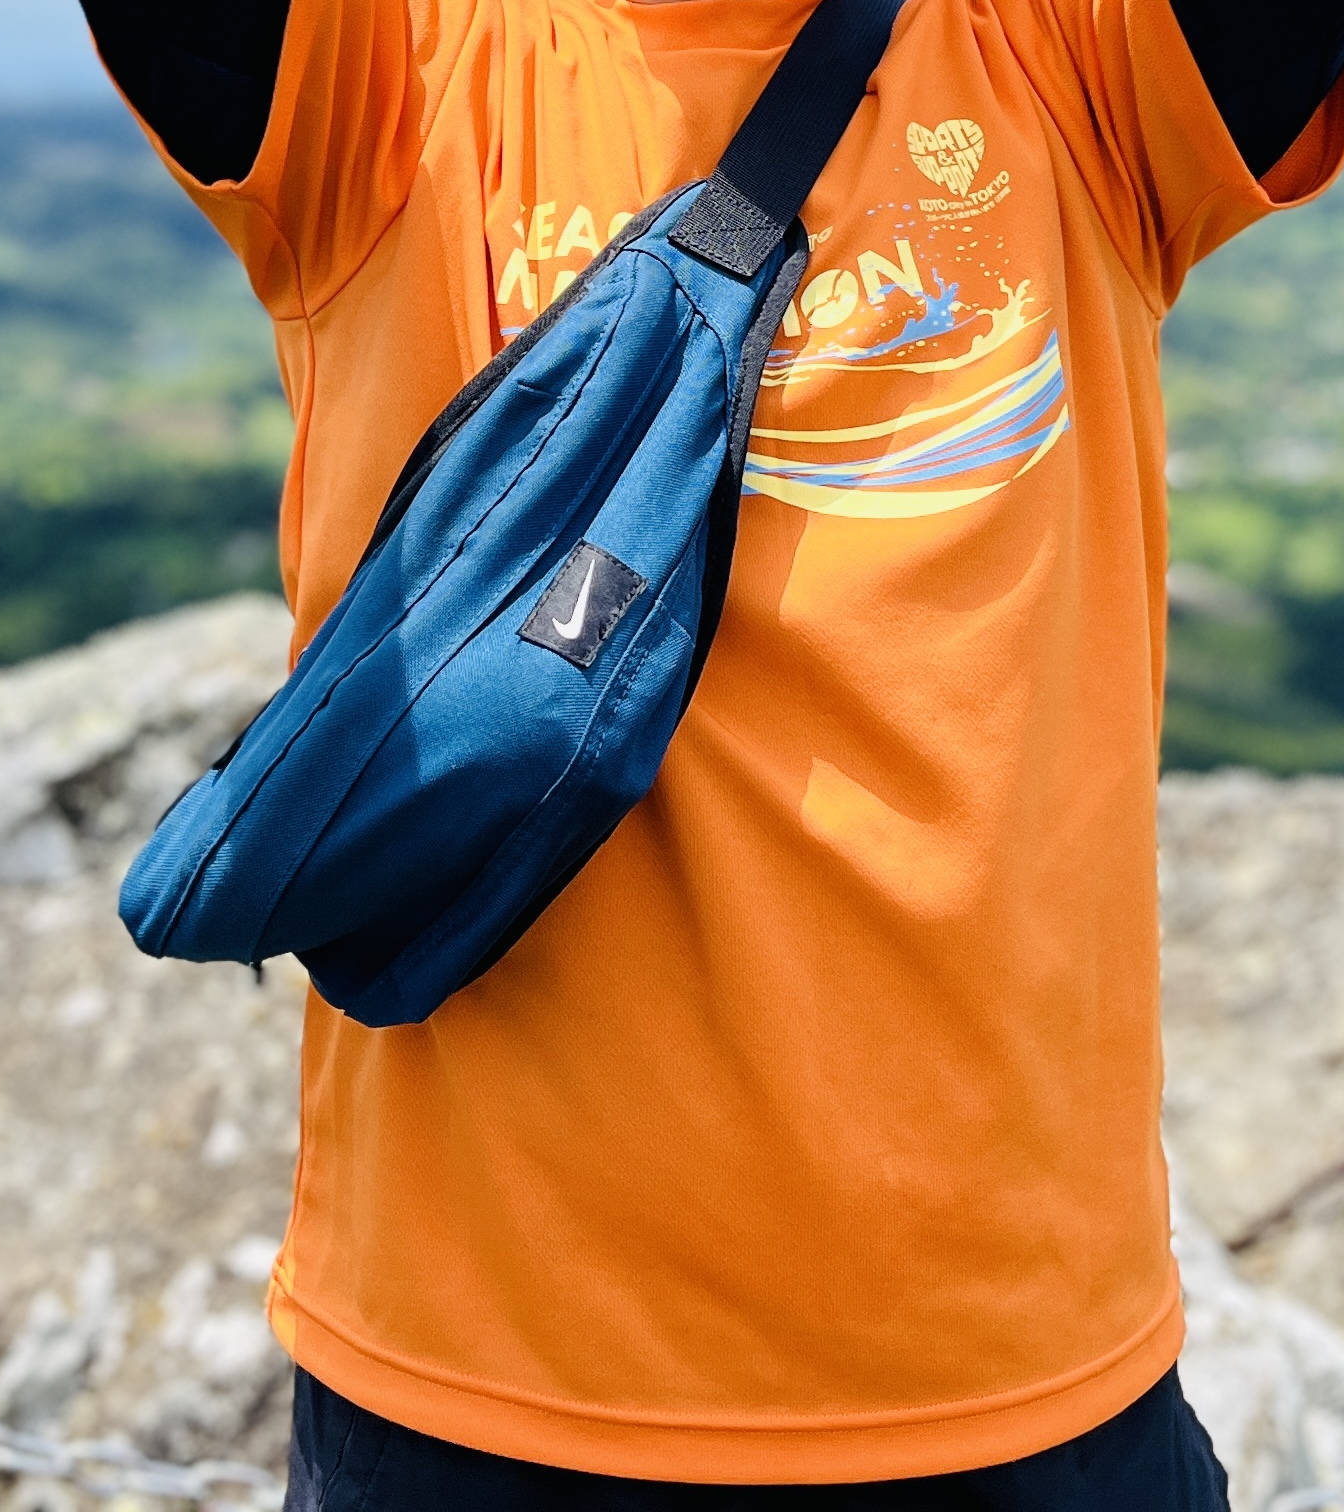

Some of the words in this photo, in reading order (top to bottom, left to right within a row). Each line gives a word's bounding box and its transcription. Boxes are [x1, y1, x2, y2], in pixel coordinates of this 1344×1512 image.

[906, 119, 984, 155] SPORTS
[937, 150, 956, 165] &
[918, 198, 949, 212] KOTO
[968, 170, 1010, 205] TOKYO
